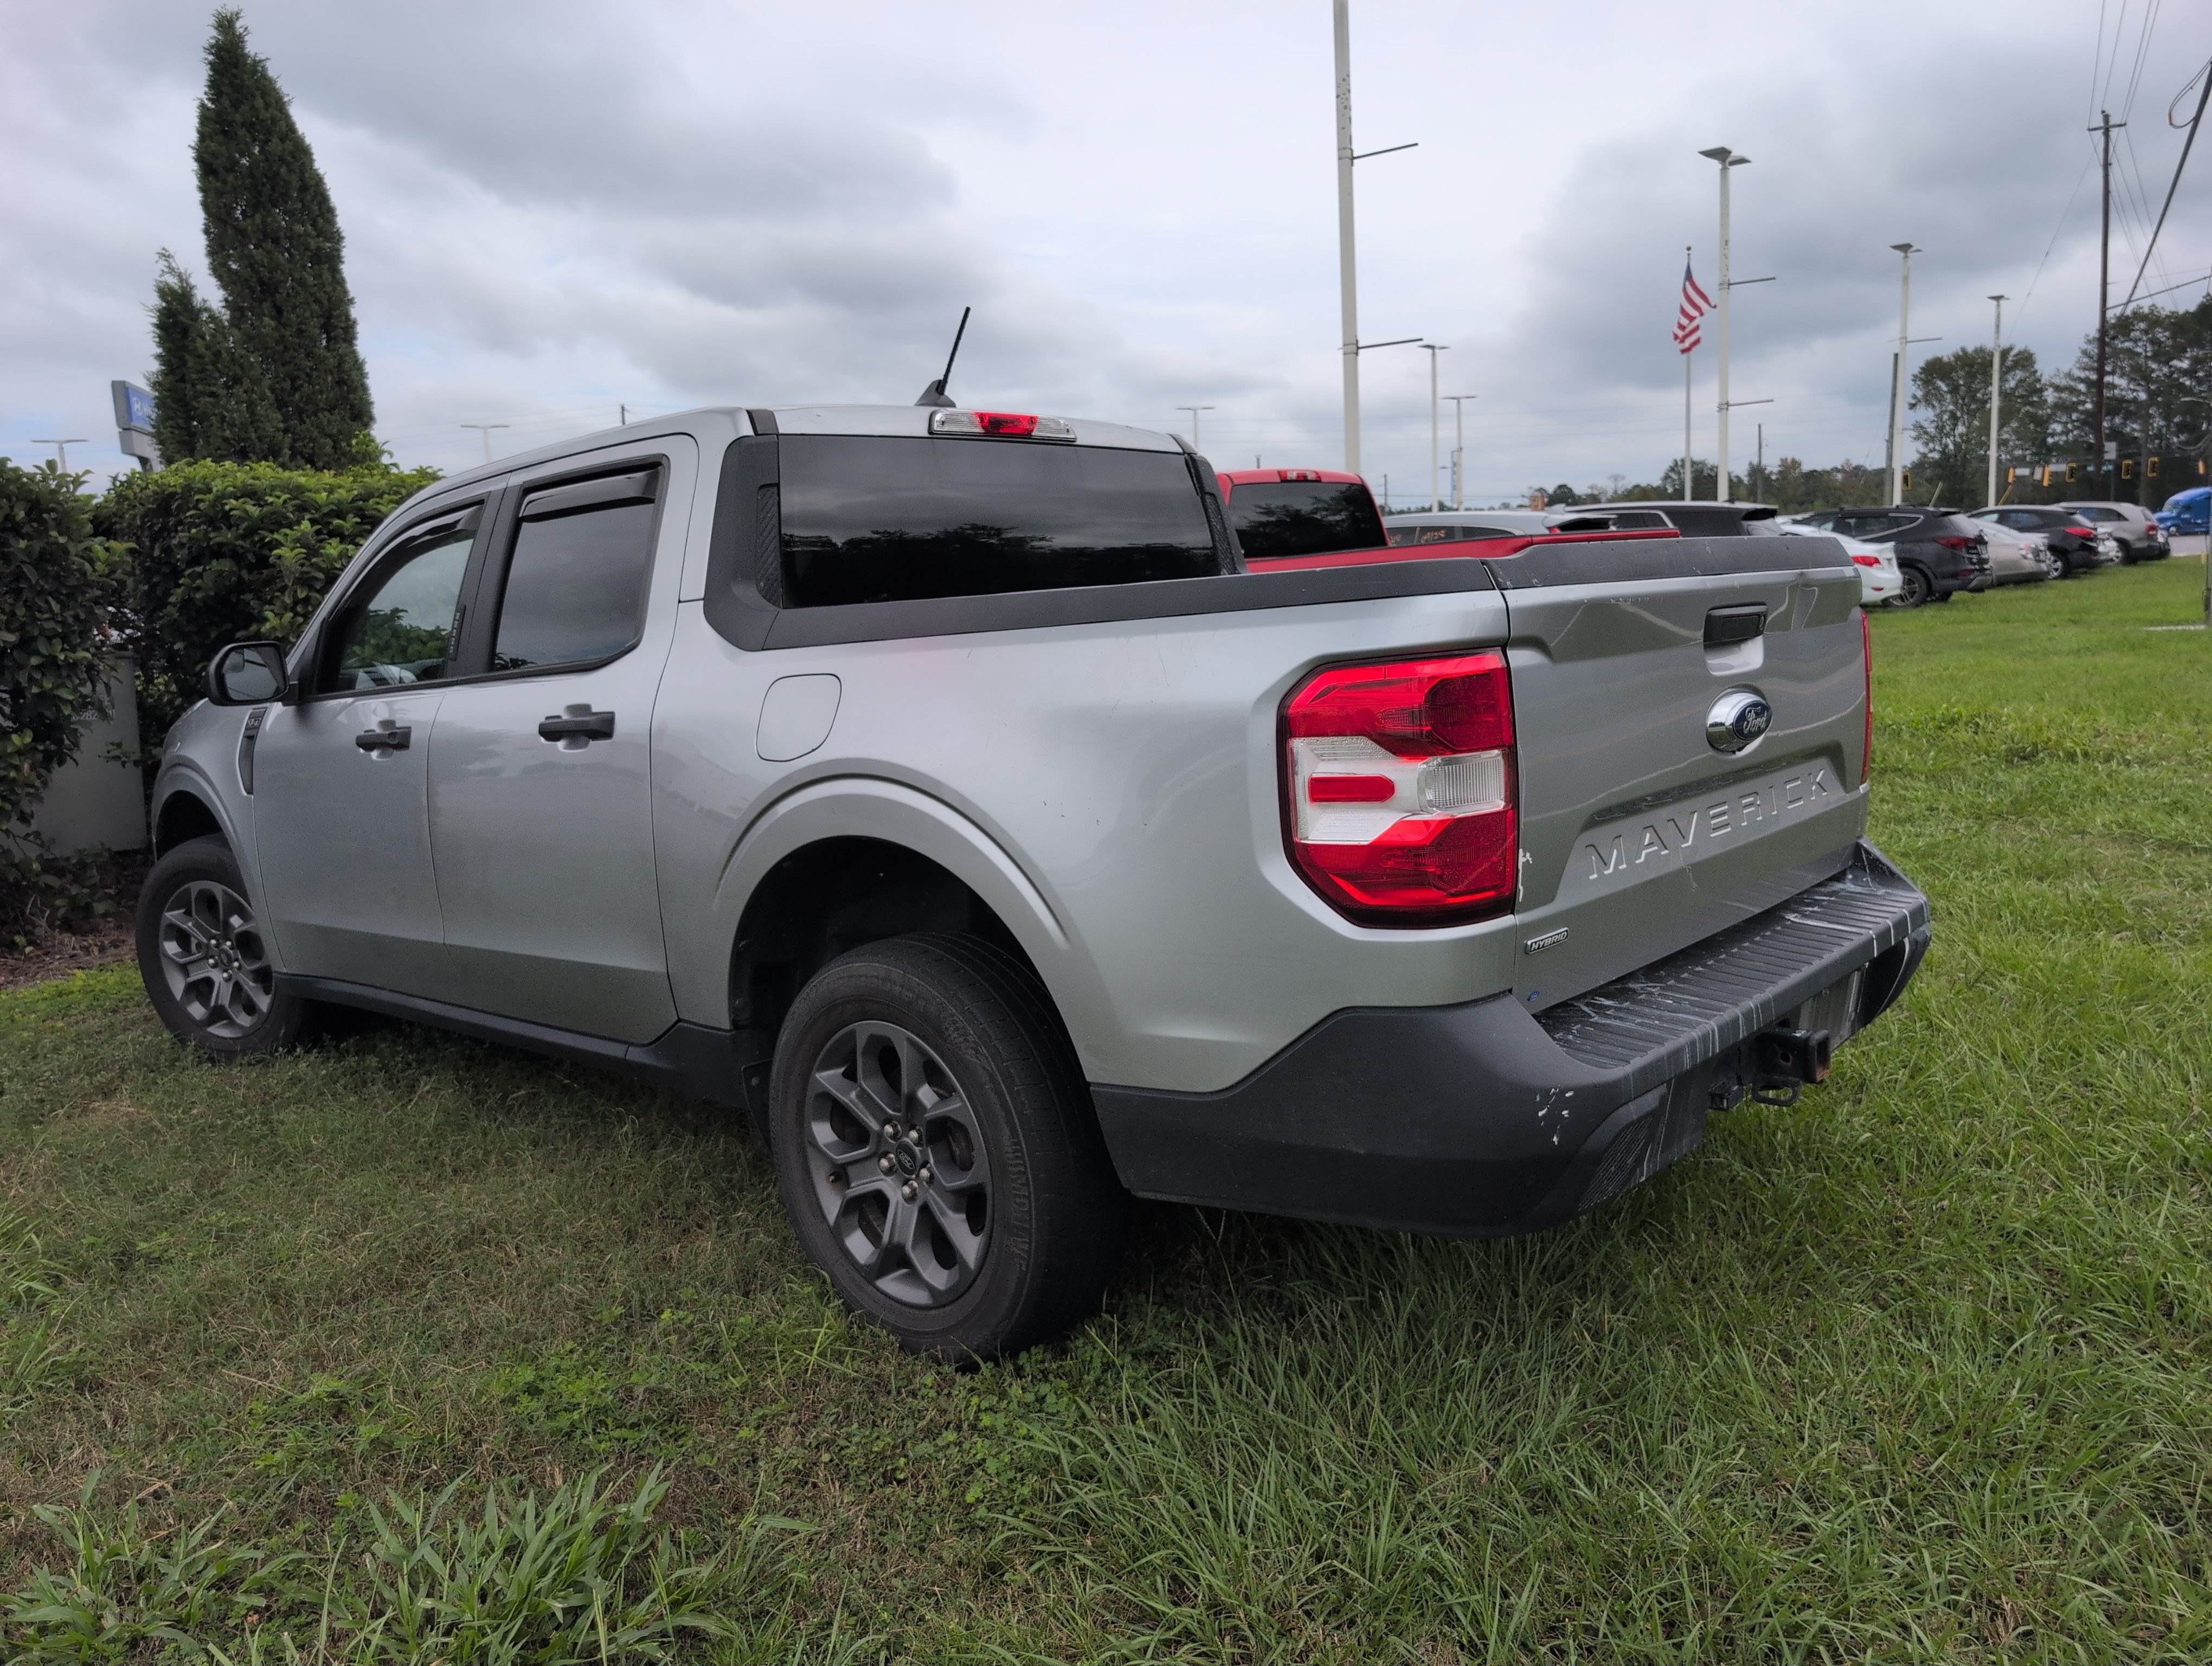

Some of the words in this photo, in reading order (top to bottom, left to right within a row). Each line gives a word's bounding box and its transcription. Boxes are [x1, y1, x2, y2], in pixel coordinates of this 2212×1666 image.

[1744, 706, 1767, 734] Ford
[1586, 769, 1828, 880] MAVERICK
[1531, 932, 1567, 951] HYBRID
